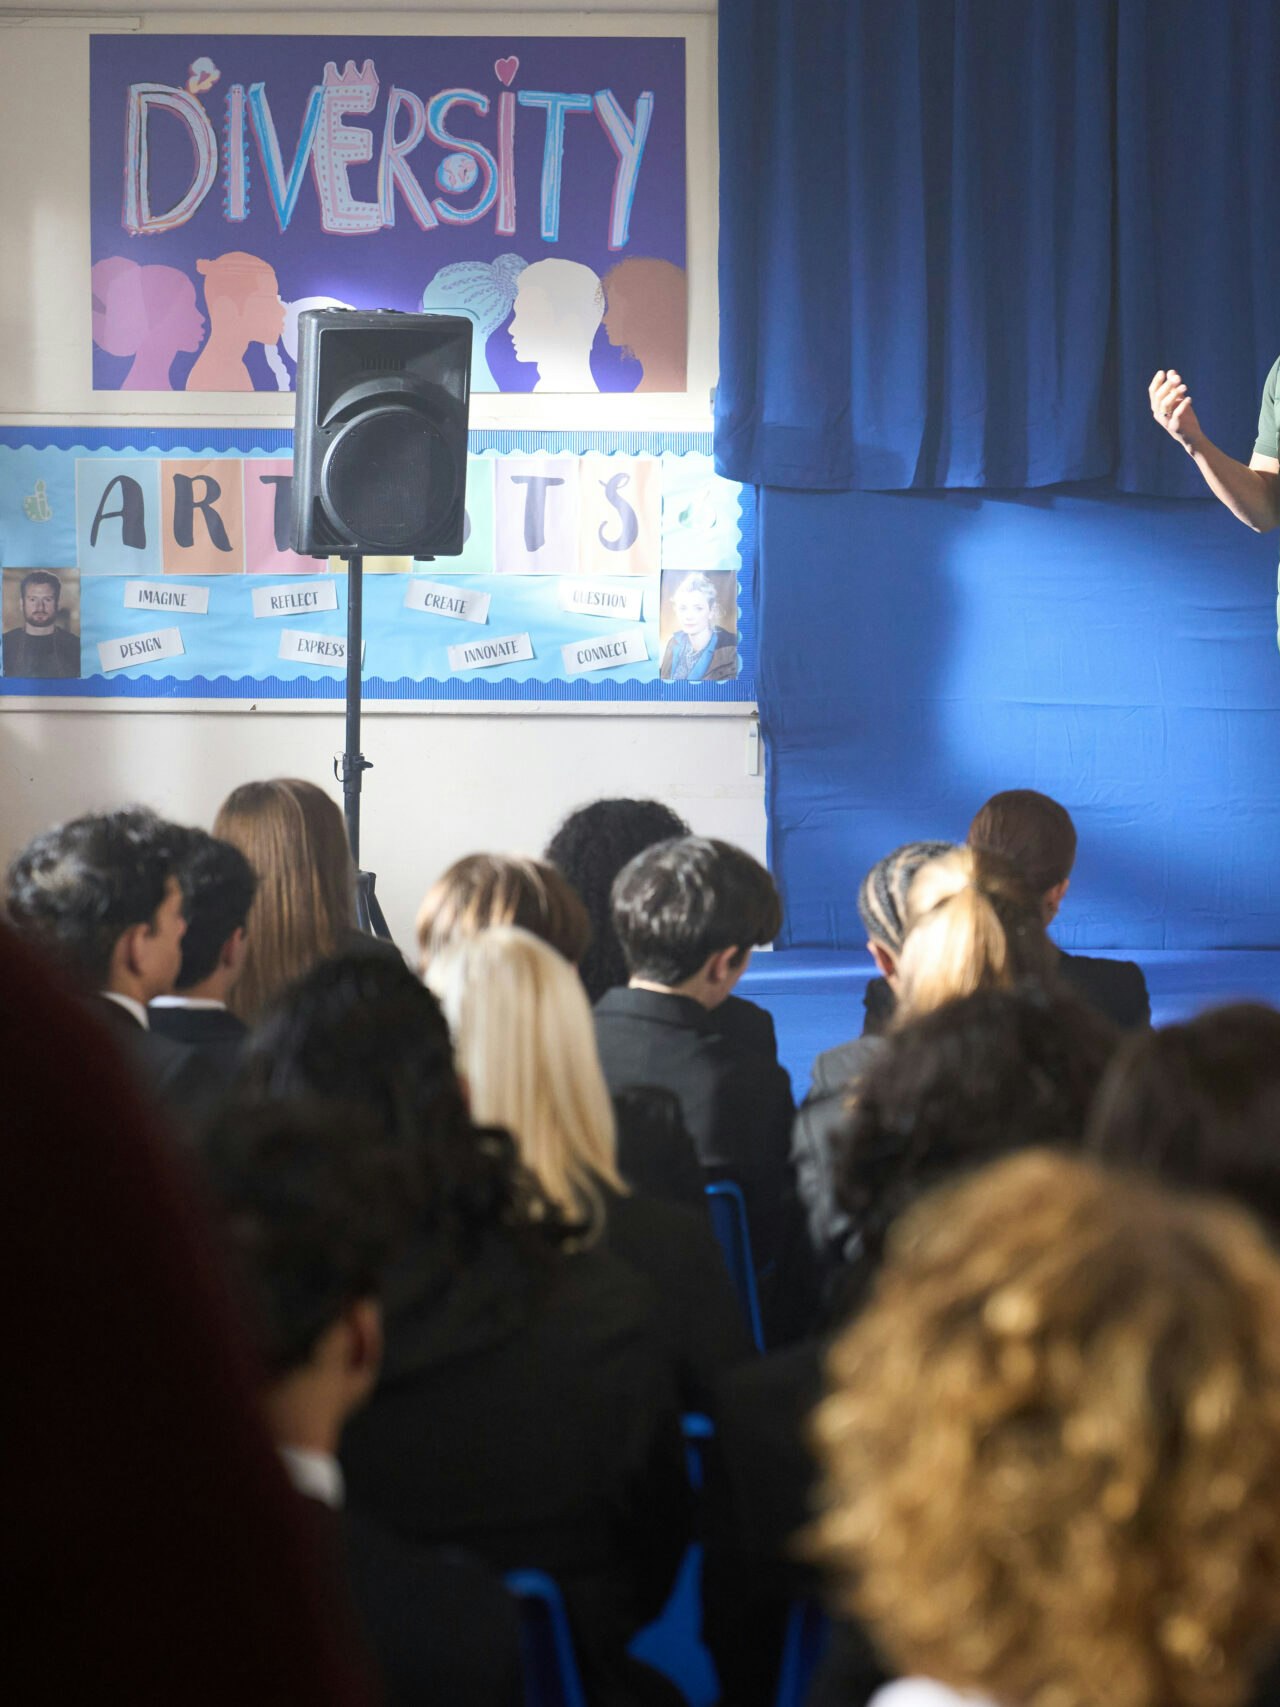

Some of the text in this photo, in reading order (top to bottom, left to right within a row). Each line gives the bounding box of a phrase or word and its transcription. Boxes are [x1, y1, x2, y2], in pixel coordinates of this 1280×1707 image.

[122, 57, 654, 251] DIVERSITY
[90, 473, 639, 552] ARTTS
[138, 590, 188, 607] IMAGINE
[270, 592, 319, 609] REFLECT
[424, 593, 467, 615] CREATE
[120, 637, 162, 658] DESIGN
[298, 638, 345, 657] EXPRESS
[464, 640, 519, 663] INNOVATE
[577, 641, 628, 665] CONNECT
